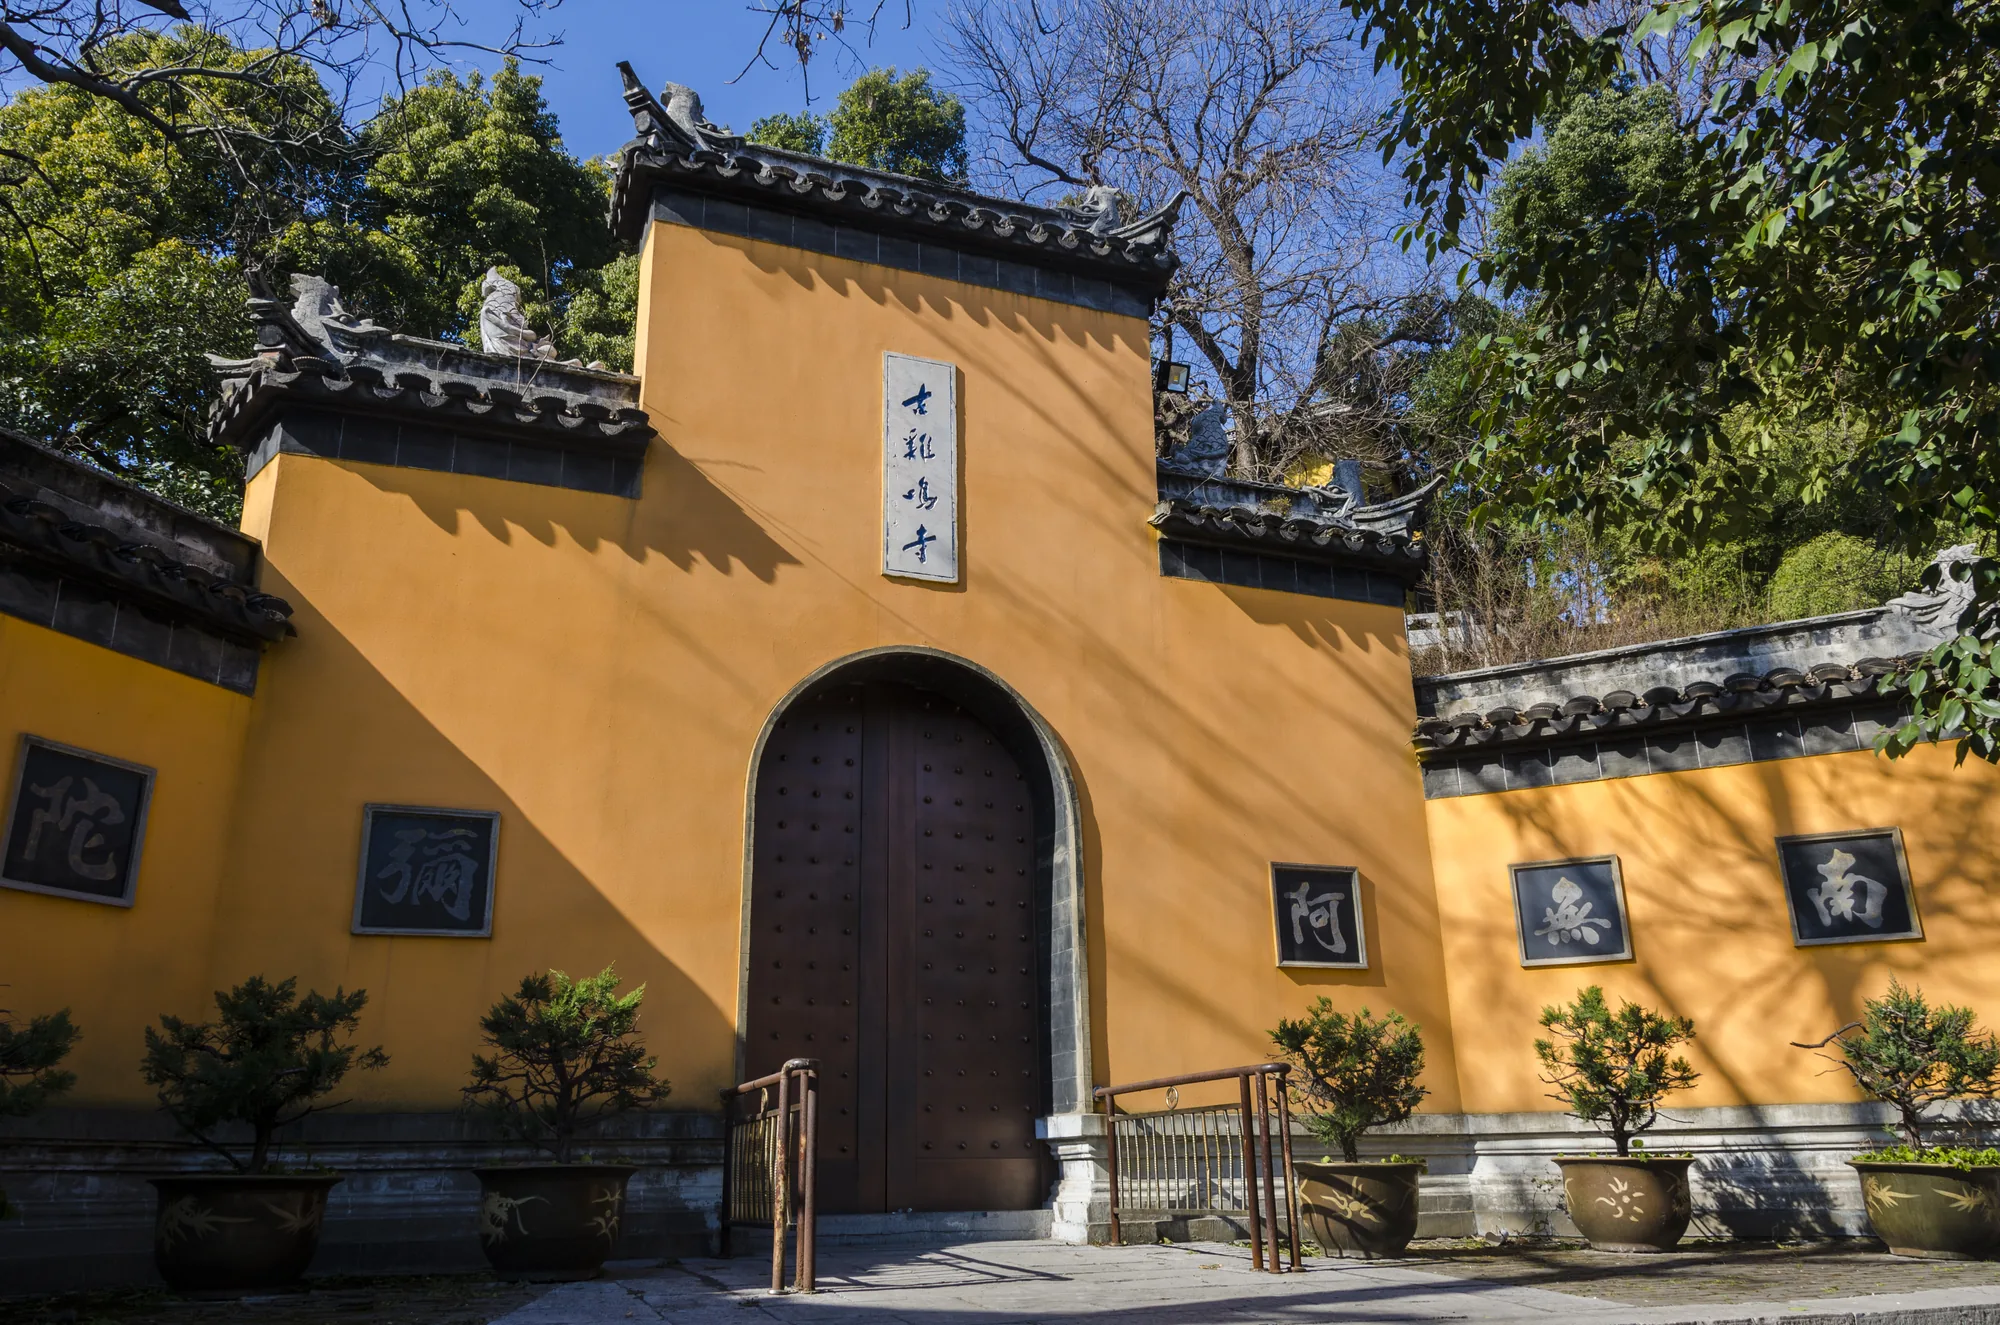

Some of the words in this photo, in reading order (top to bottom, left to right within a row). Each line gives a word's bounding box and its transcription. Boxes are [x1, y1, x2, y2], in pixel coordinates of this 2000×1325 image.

[1283, 881, 1347, 954] 阿
[1533, 876, 1612, 946] 無
[1806, 848, 1888, 928] 南
